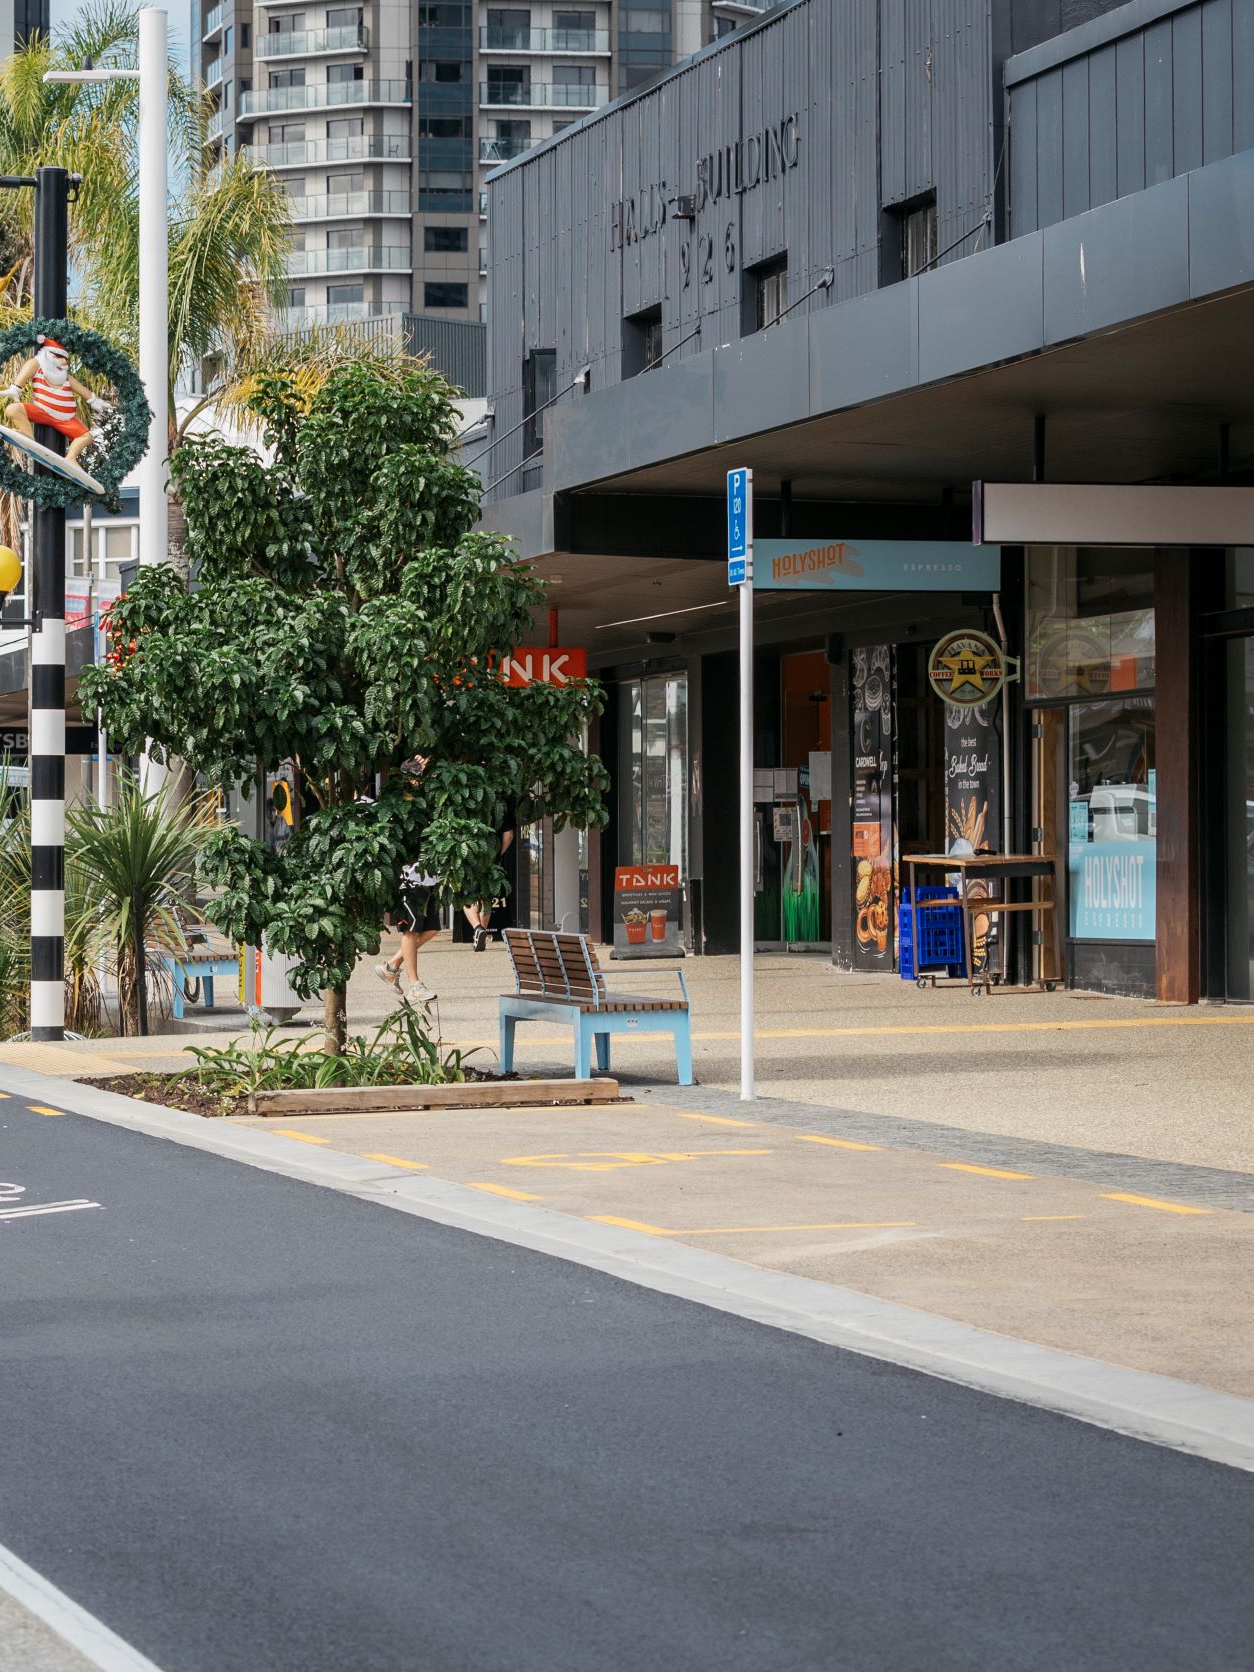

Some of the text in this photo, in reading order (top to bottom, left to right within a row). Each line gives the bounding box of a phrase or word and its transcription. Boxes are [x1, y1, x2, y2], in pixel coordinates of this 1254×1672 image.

[696, 114, 801, 213] BUILDING
[733, 474, 741, 495] P
[772, 543, 962, 580] HOLYSHOT ESPRESSO
[929, 670, 1003, 680] COFFEE WORKS
[855, 756, 877, 768] CARDWELL
[949, 755, 968, 777] Baked
[619, 873, 675, 887] TANK
[1084, 856, 1144, 909] HOLYSHOT
